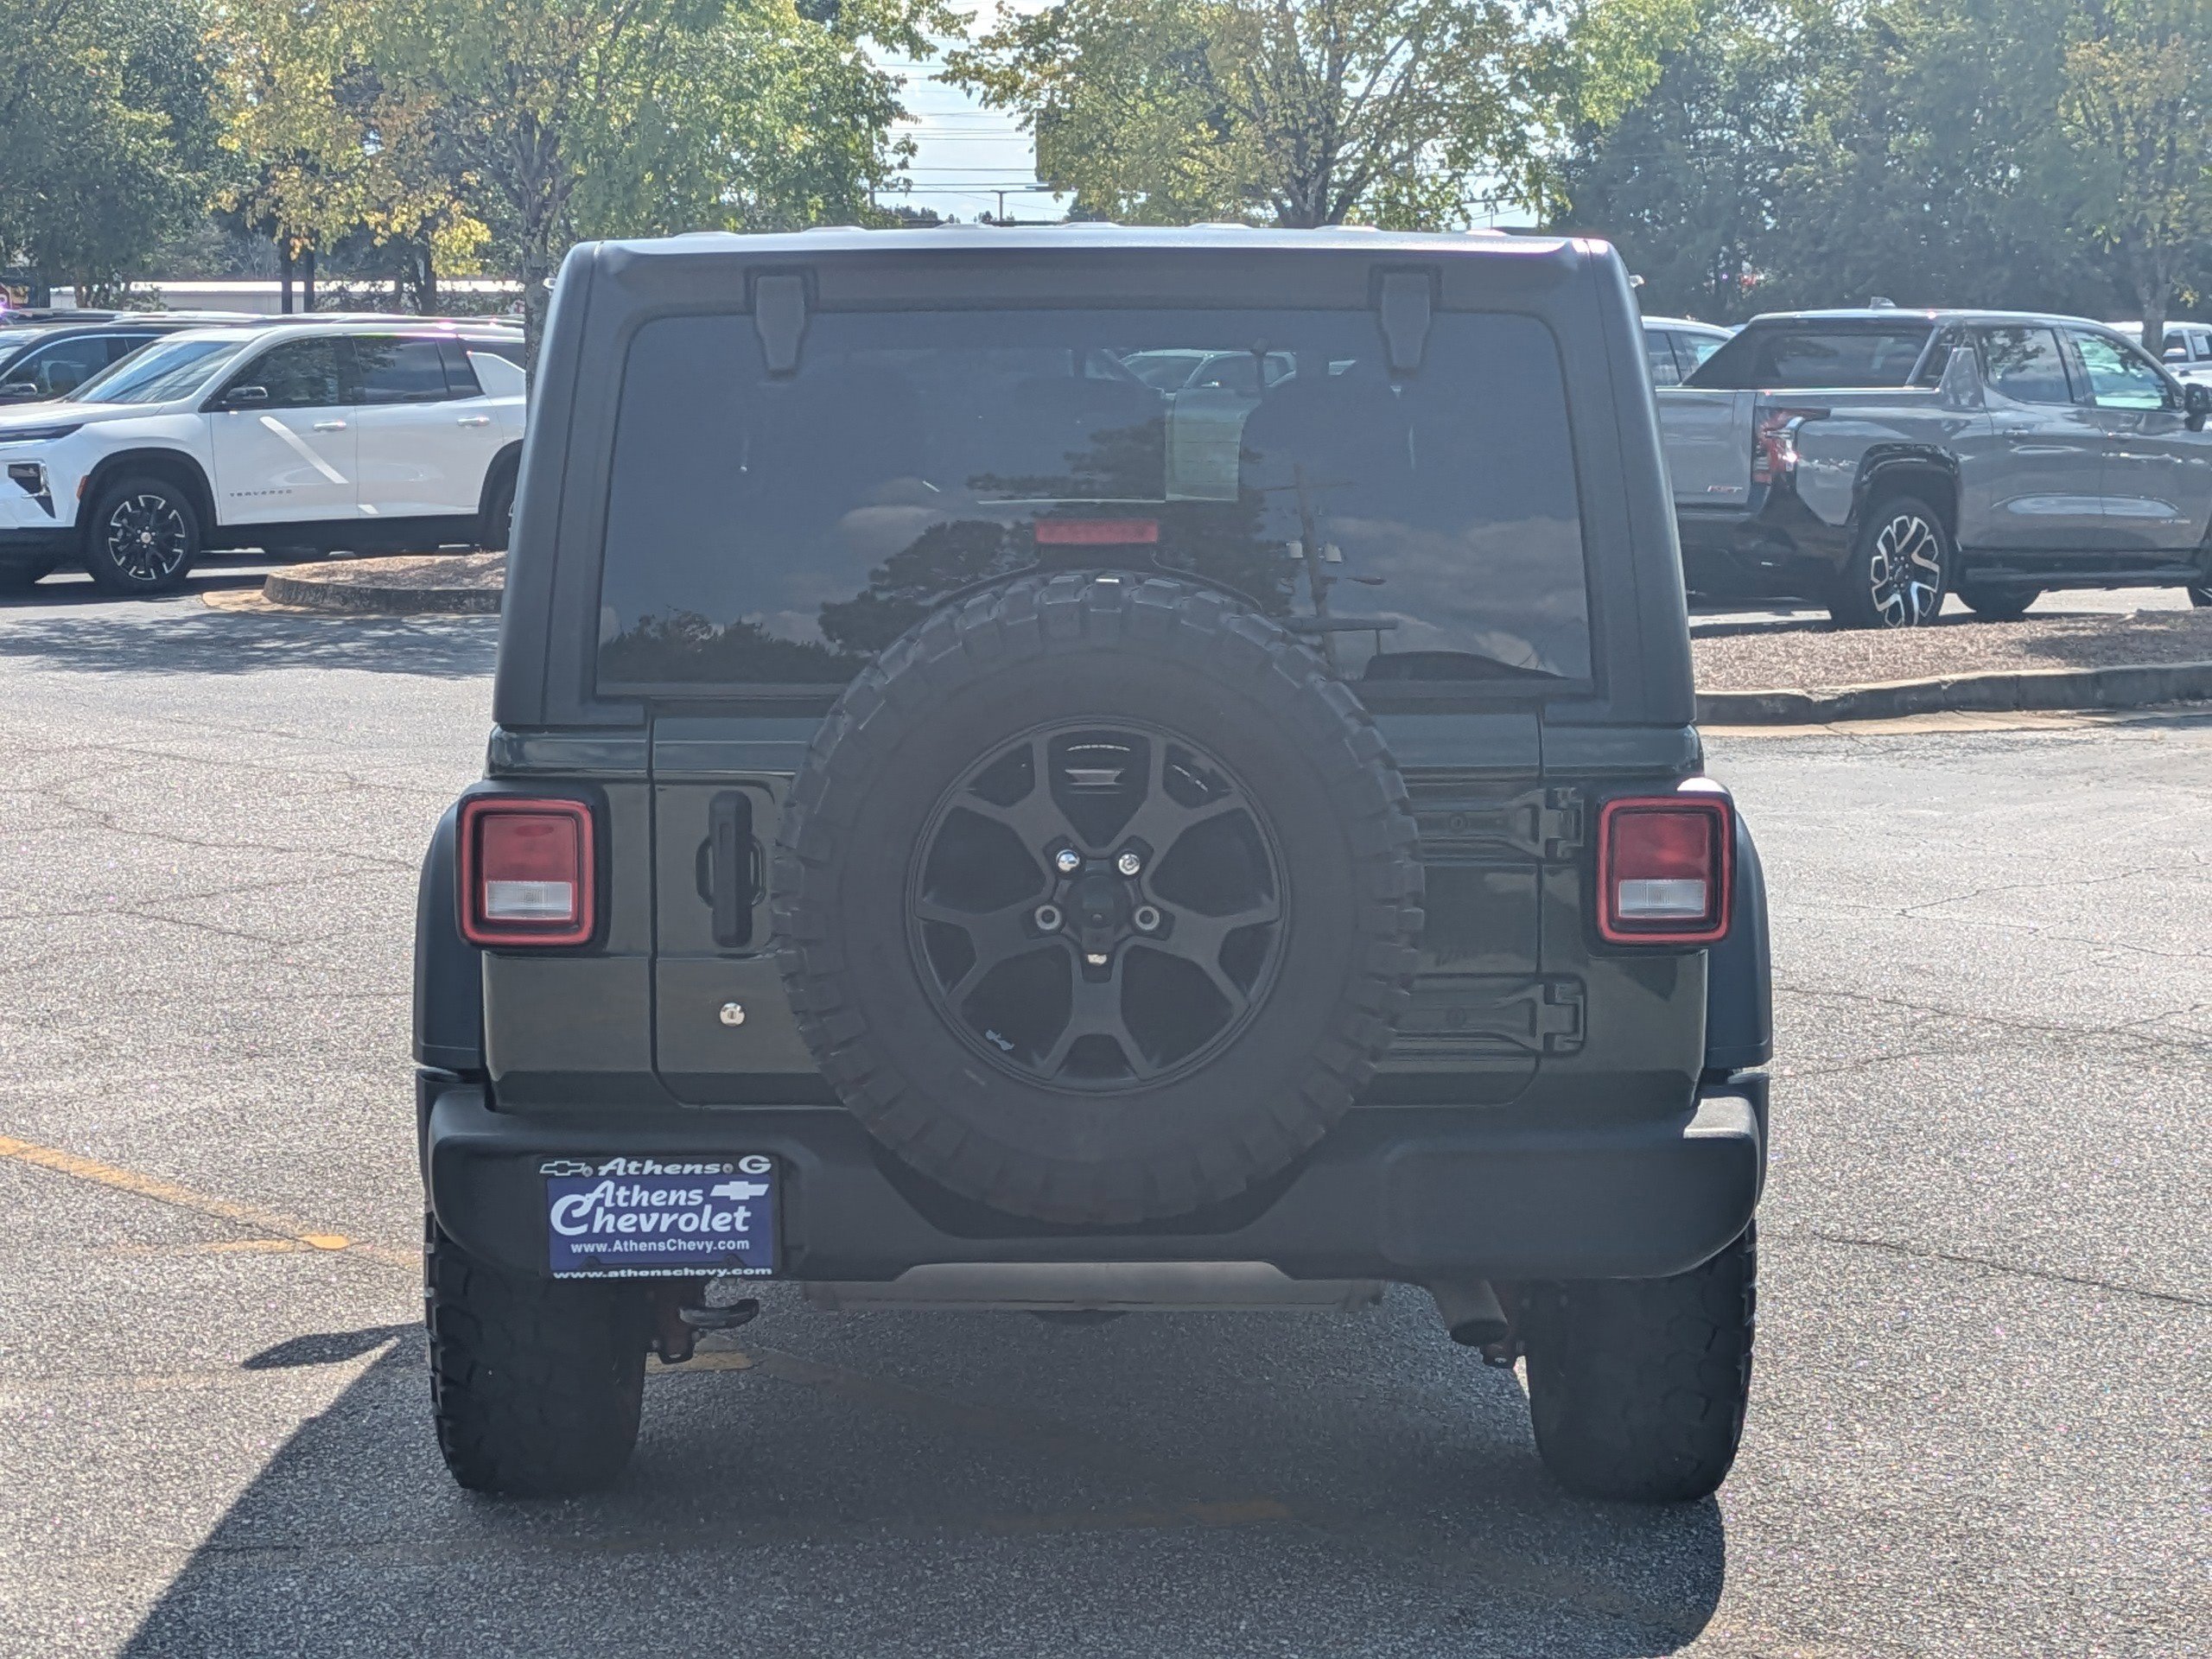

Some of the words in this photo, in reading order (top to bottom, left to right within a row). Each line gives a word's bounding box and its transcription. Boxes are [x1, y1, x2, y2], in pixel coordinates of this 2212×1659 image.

[598, 1157, 721, 1176] Athens
[738, 1154, 772, 1174] G
[587, 1180, 703, 1208] Athens
[550, 1194, 752, 1236] Chevrolet
[570, 1238, 750, 1254] www.AthensChevy.com
[553, 1267, 772, 1279] www.athenschevy.com
